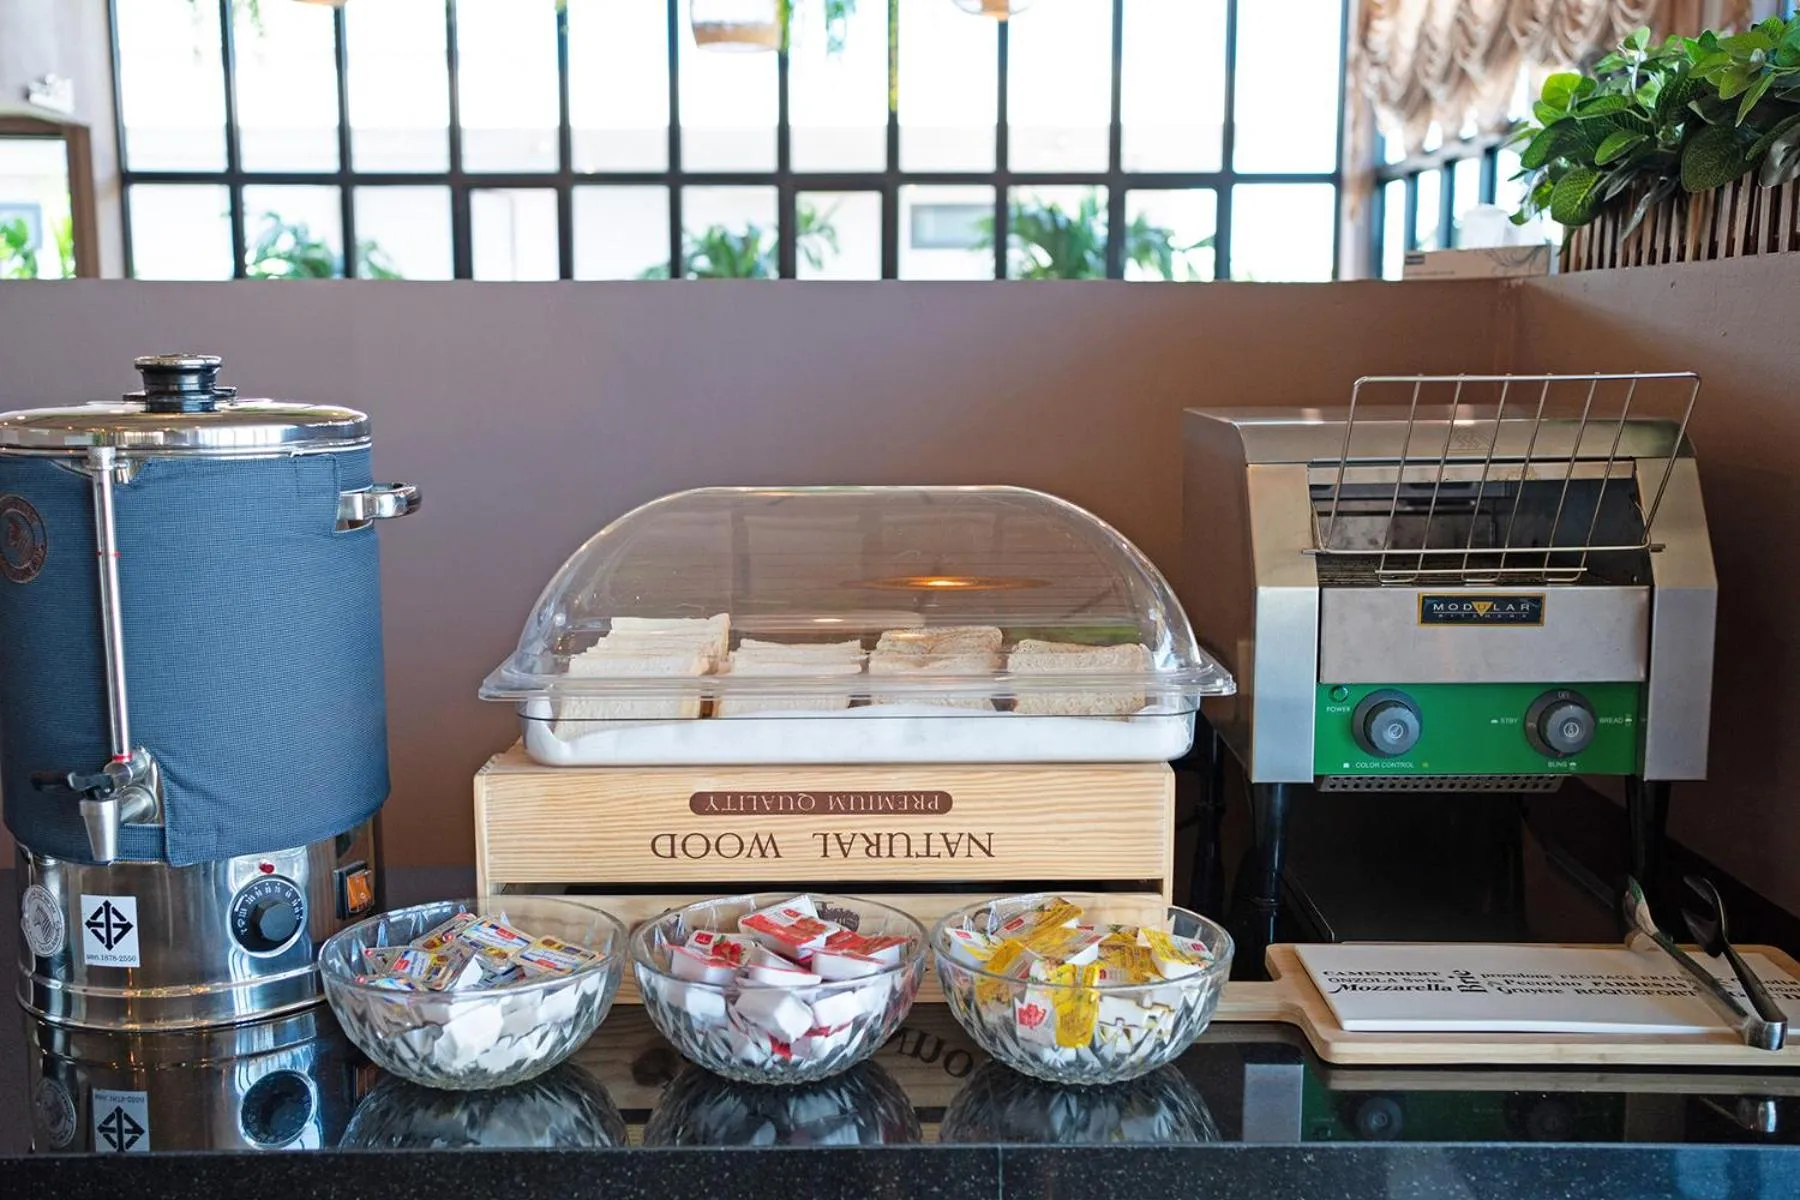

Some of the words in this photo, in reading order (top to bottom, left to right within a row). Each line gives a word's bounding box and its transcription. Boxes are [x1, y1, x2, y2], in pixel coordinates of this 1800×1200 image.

[1599, 717, 1624, 725] BREAD
[1355, 761, 1380, 769] COLOR
[1381, 761, 1414, 769] CONTROL
[704, 793, 816, 811] QUALITY
[828, 794, 940, 811] PREMIUM
[650, 832, 784, 860] WOOD
[811, 831, 996, 859] NATURAL
[1327, 983, 1453, 994] Mozzarella
[1447, 970, 1489, 993] Brie
[1591, 981, 1687, 989] PARMESAN
[1574, 988, 1697, 997] ROQUEFORT
